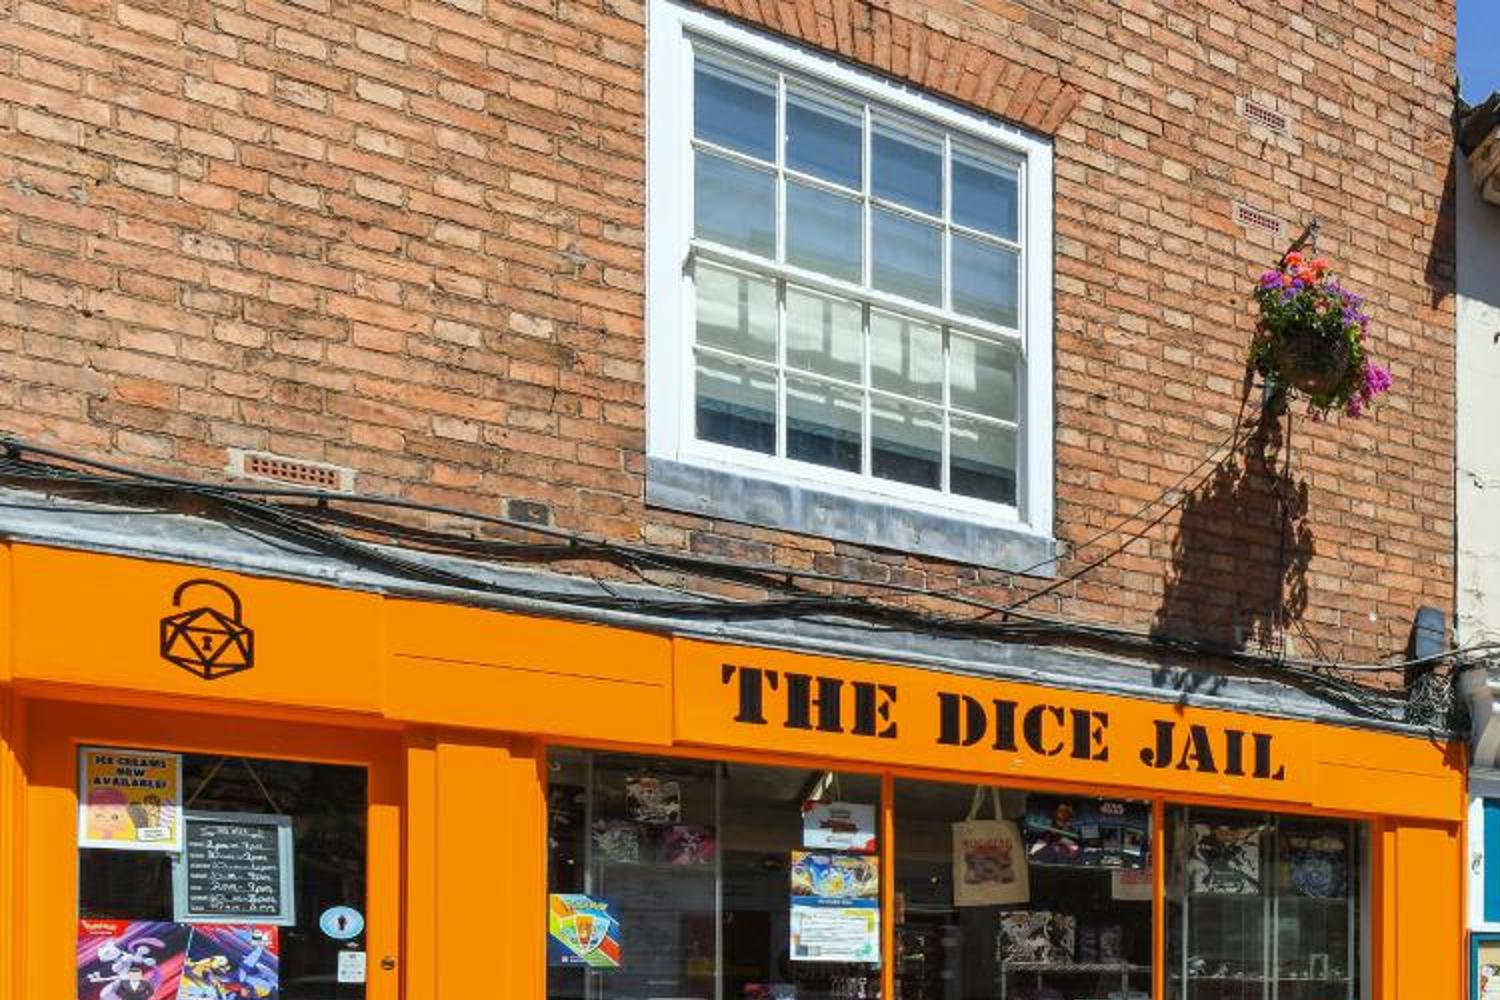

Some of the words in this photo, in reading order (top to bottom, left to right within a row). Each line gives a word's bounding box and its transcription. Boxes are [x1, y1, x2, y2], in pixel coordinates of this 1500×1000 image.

[721, 663, 898, 739] THE
[936, 691, 1110, 762] DICE
[1139, 719, 1286, 781] JAIL
[117, 757, 167, 769] CREAMS
[116, 767, 146, 777] NOW
